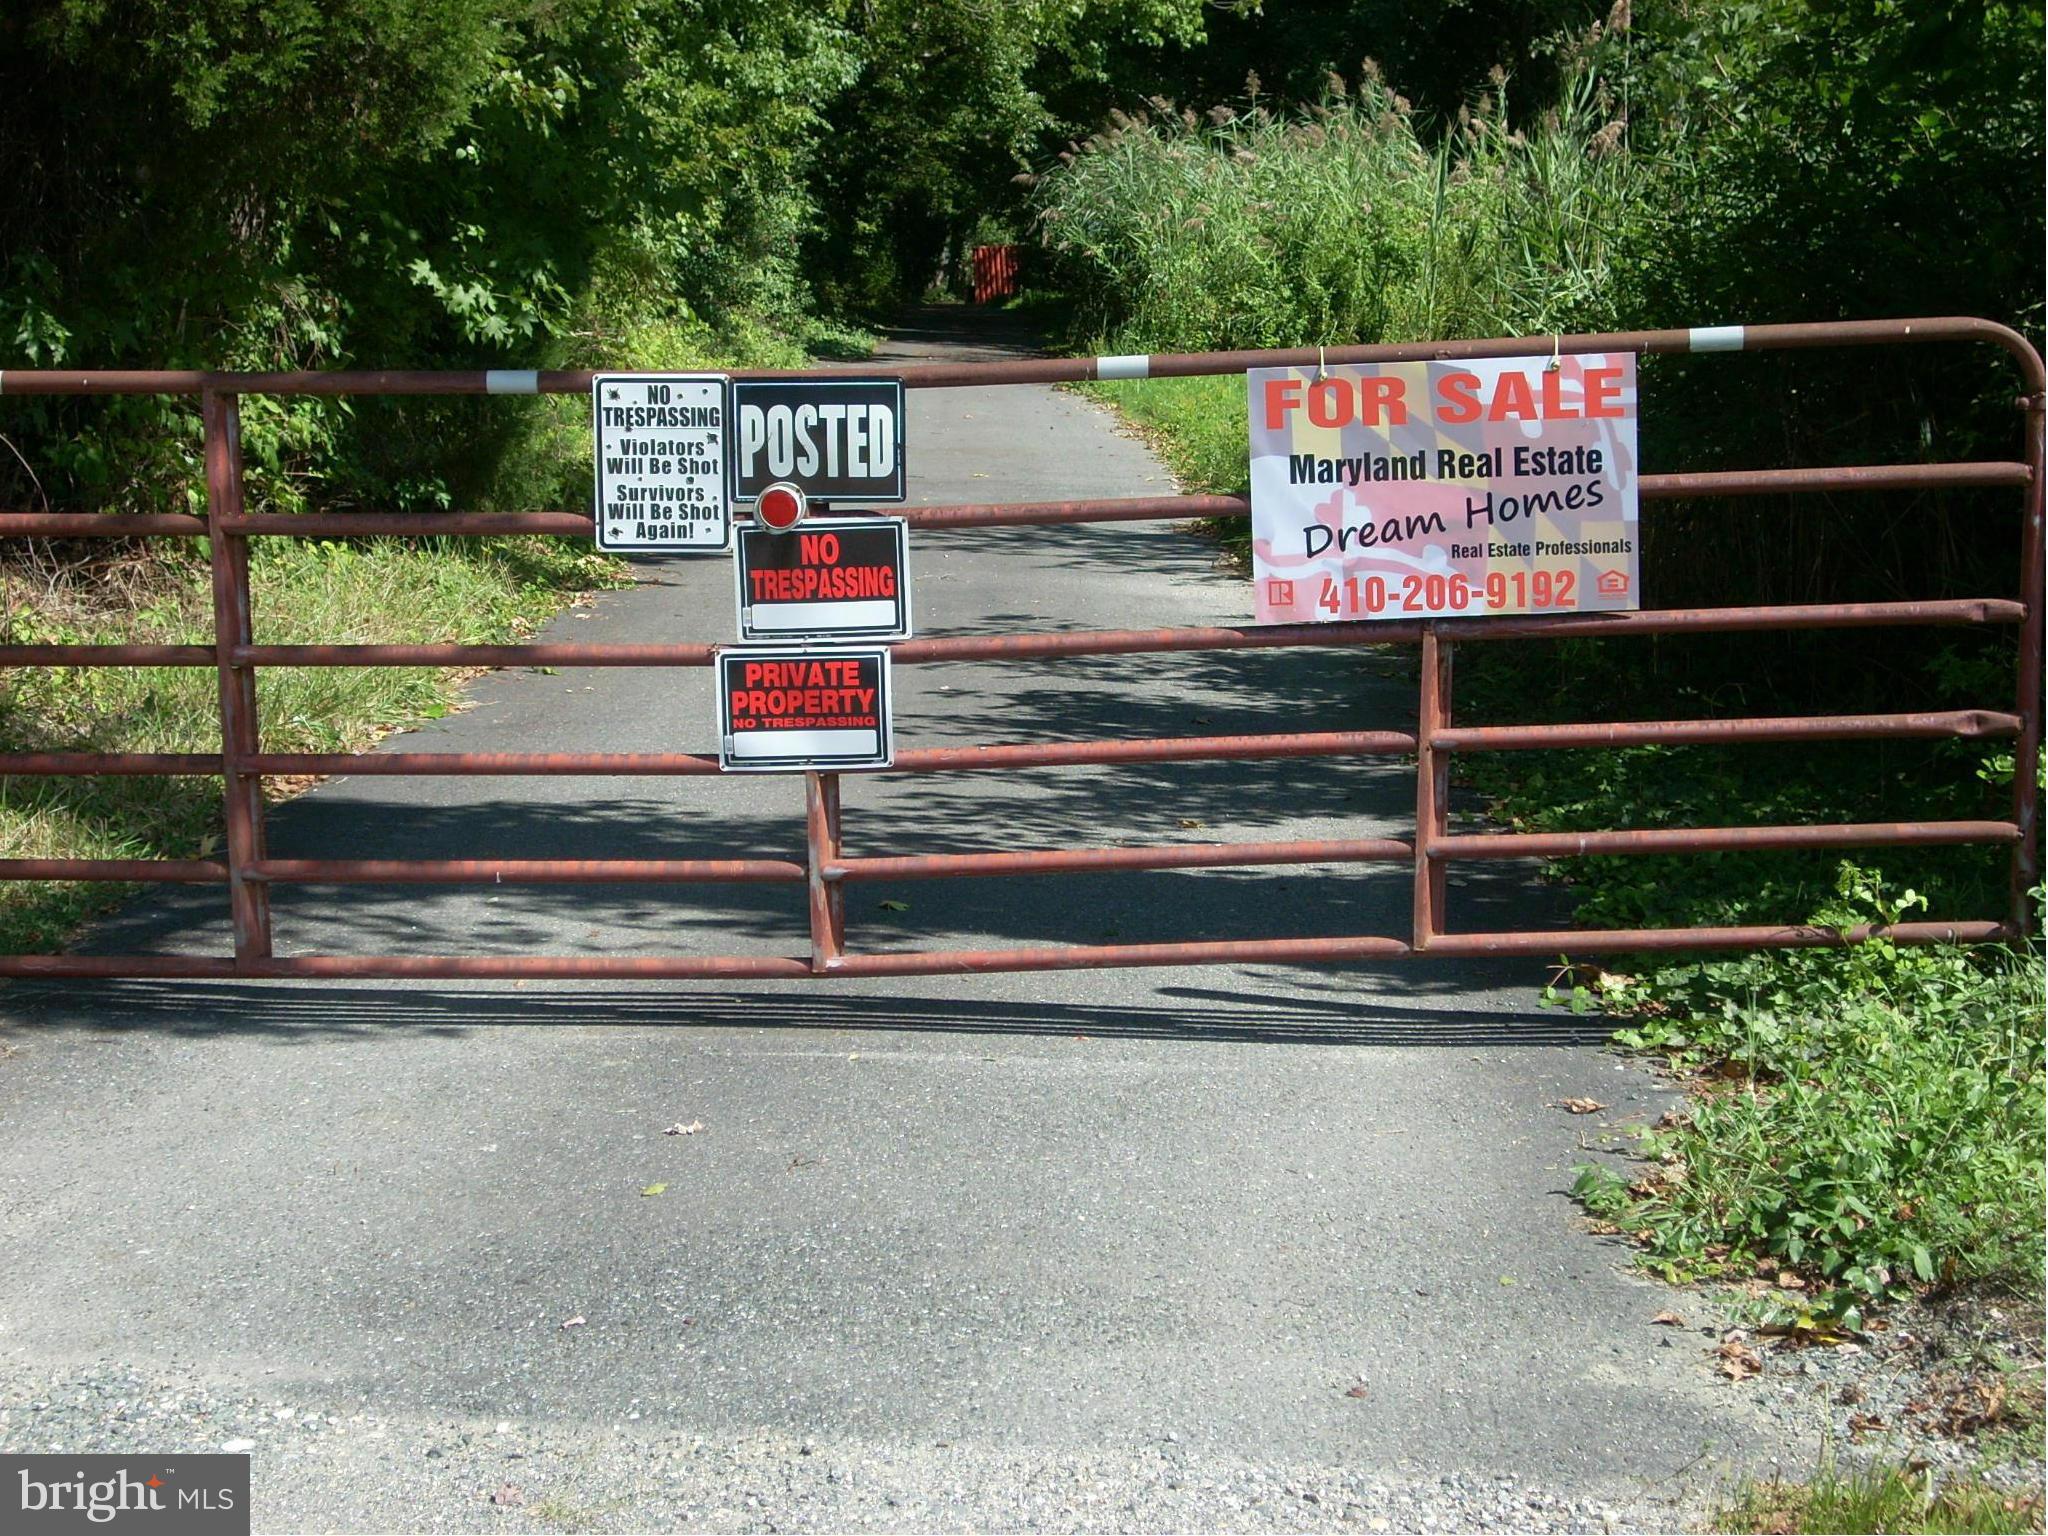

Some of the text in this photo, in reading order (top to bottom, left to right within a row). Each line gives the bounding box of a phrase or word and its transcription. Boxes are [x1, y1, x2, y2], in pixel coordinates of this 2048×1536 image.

[647, 385, 671, 405] NO
[1264, 367, 1625, 431] FOR SALE
[603, 407, 720, 427] TRESPASSING
[620, 439, 705, 456] Violators
[740, 403, 894, 478] POSTED
[606, 457, 719, 475] Will Be Shot
[1289, 445, 1603, 487] Maryland Real Estate
[616, 484, 705, 501] Survivors
[608, 503, 720, 520] Will Be Shot
[1303, 480, 1604, 559] Dream Homes
[636, 522, 694, 540] Again!
[800, 534, 839, 565] NO
[1451, 538, 1632, 559] Real Estate Professionals
[751, 566, 894, 600] TRESPASSING
[1319, 570, 1577, 614] 410-206-9192
[746, 661, 860, 688] PRIVATE
[732, 688, 874, 716] PROPERTY
[733, 716, 876, 729] NO TRESPASSING
